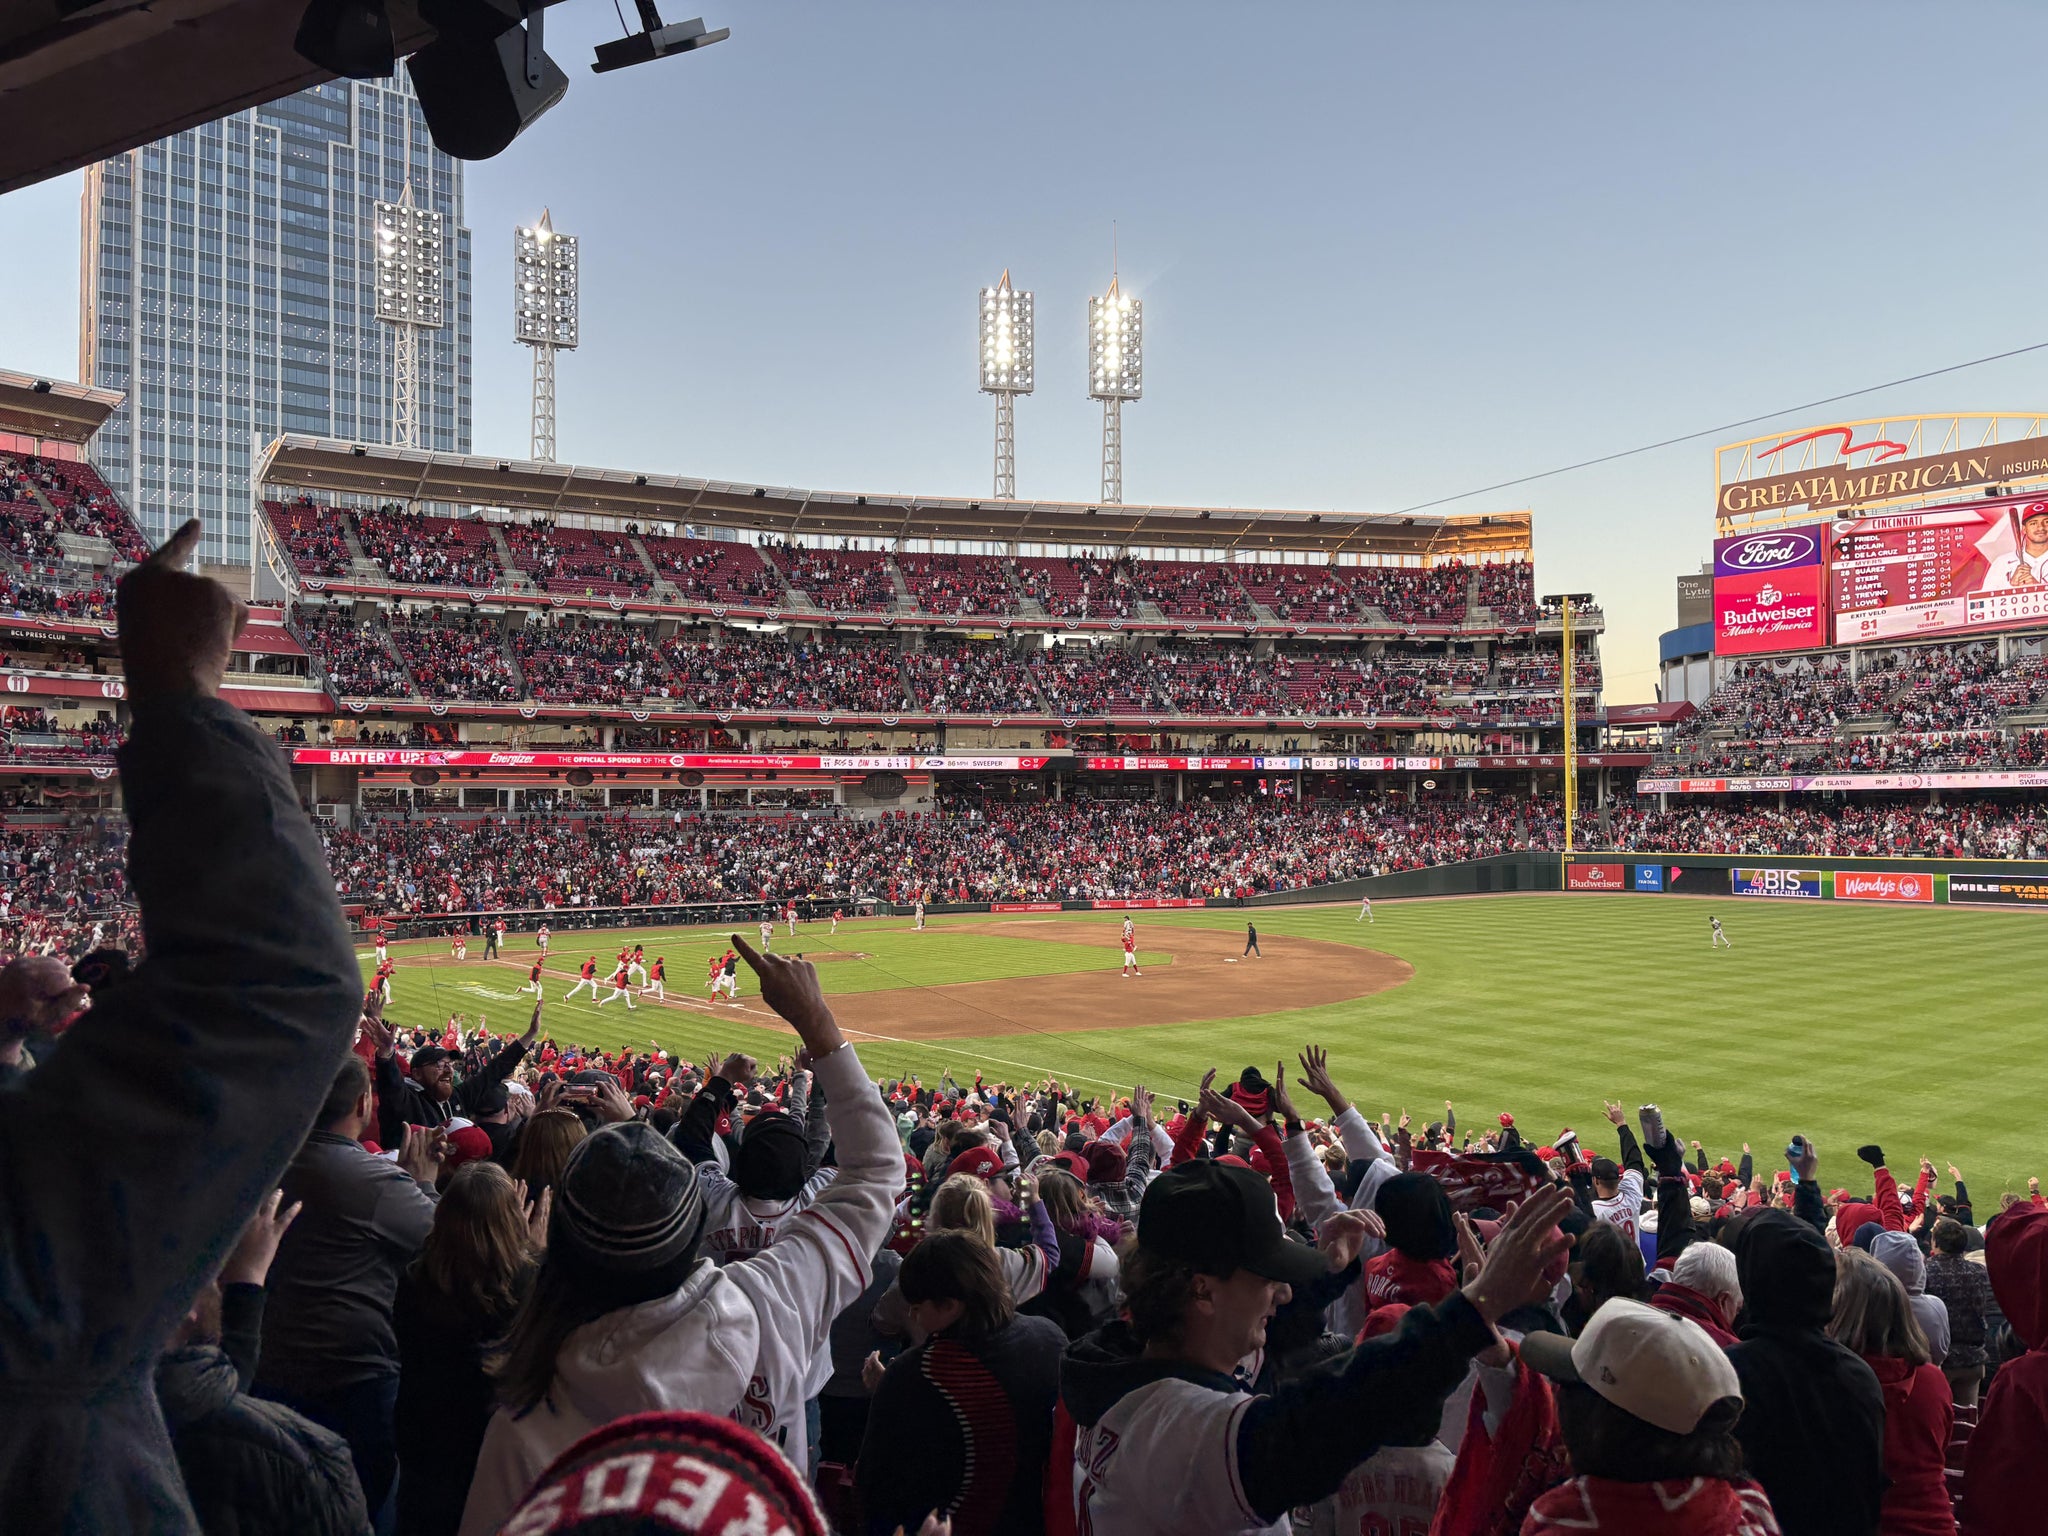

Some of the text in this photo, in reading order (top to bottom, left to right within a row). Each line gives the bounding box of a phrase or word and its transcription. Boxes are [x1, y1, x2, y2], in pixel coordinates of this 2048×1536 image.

[1723, 456, 2048, 511] GREAT AMERICAN INSURA
[1872, 516, 1922, 529] CINCINNATI
[1738, 538, 1796, 565] Ford
[1855, 566, 1885, 574] SUÁREZ
[1686, 588, 1710, 596] Lytle
[1855, 590, 1888, 598] TREVINO
[1906, 603, 1932, 611] LAUNCH
[1724, 606, 1815, 625] Budweiser
[1924, 611, 1938, 621] 17
[1722, 620, 1813, 637] Made of America
[1861, 619, 1877, 630] 81
[12, 677, 24, 690] 11
[106, 683, 120, 696] 14
[330, 752, 424, 763] BATTERY UP!
[489, 752, 535, 765] Energizer
[858, 759, 869, 767] CIN
[1756, 780, 1789, 789] $30,570
[1570, 879, 1622, 887] Budweiser
[1751, 870, 1801, 890] 4BIS
[1845, 877, 1896, 896] Wendy's
[1609, 1208, 1632, 1223] VOTTO
